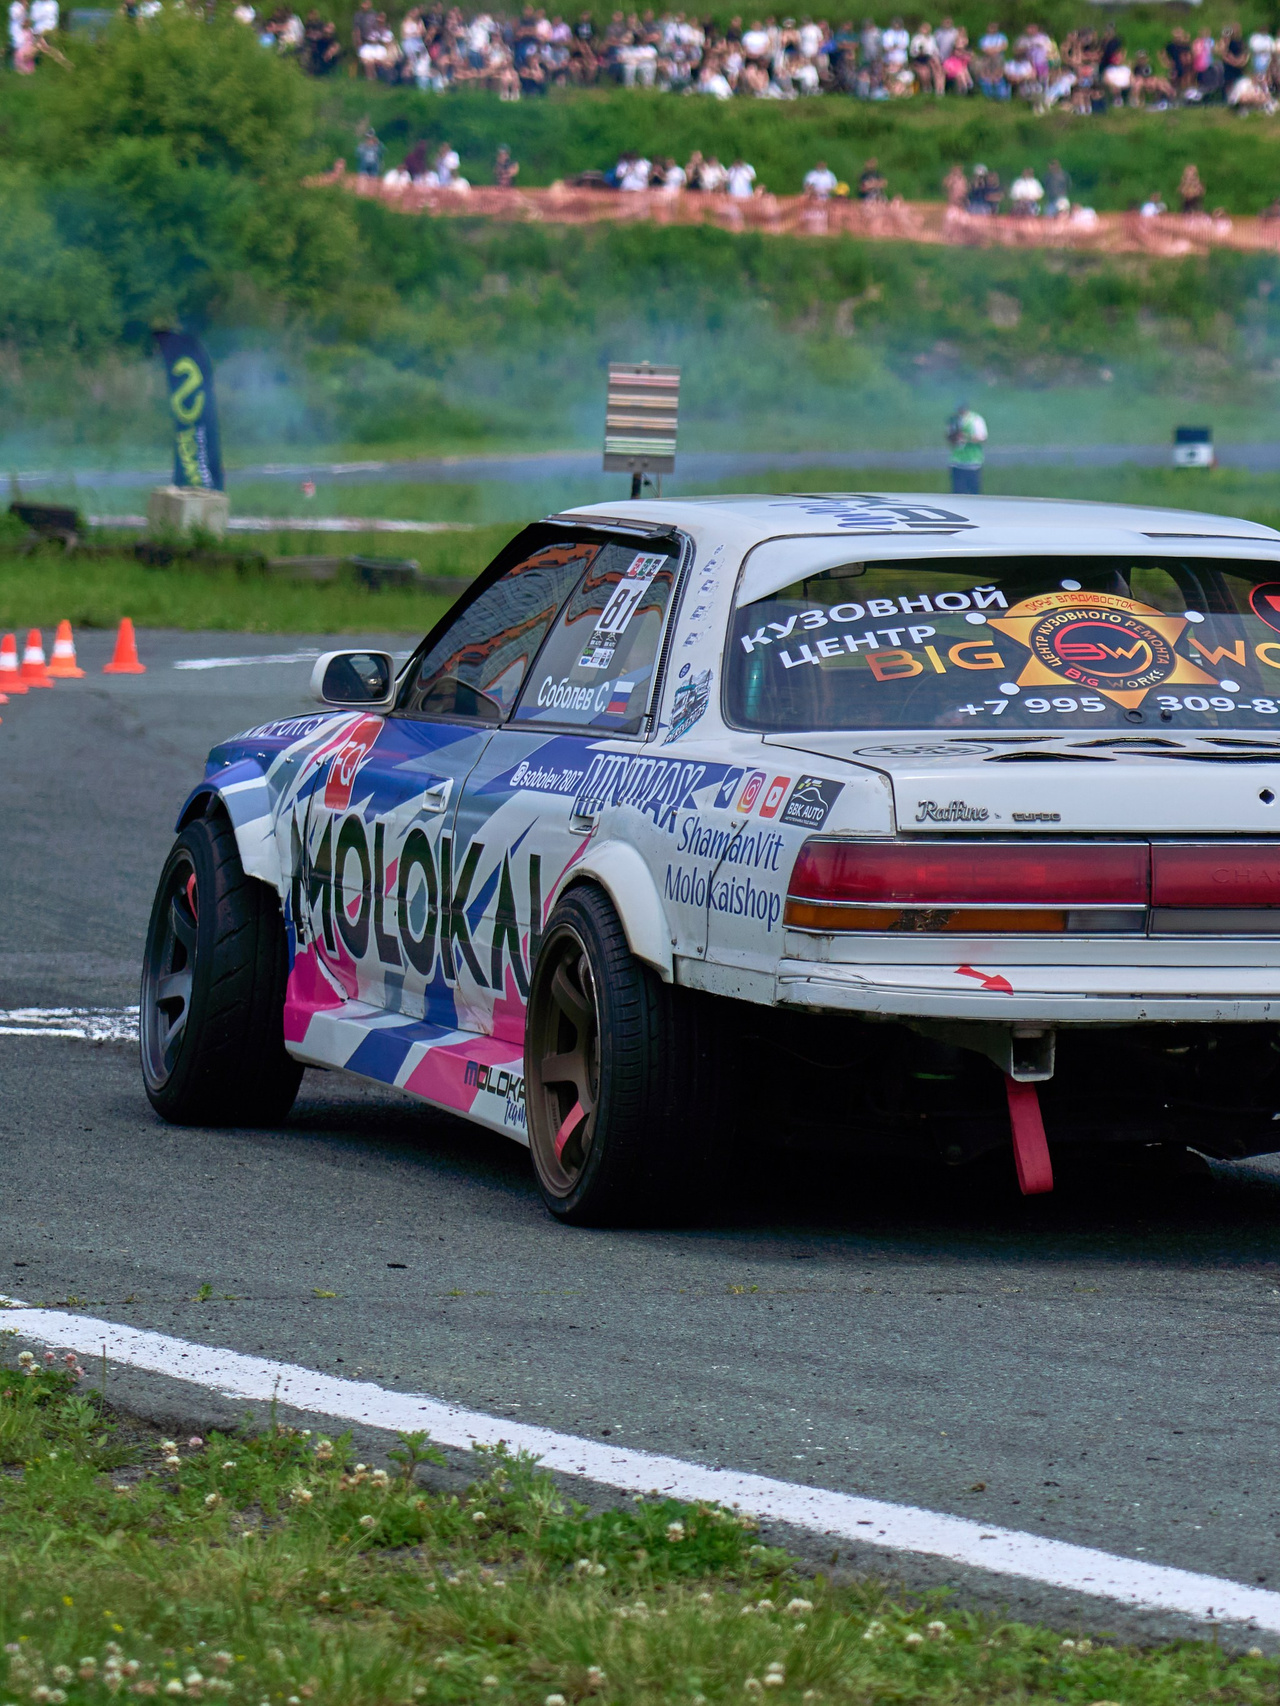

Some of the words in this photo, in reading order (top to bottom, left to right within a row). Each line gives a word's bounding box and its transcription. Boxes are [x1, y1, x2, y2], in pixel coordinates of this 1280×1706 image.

[599, 588, 644, 631] 81
[740, 586, 1009, 653] КУЗОВНОЙ
[1037, 610, 1122, 636] КУЗОВНОГО
[1056, 594, 1136, 611] ВЛАДИВОСТОК
[779, 625, 936, 669] ЦЕНТР
[865, 640, 1006, 682] BIG
[1036, 634, 1062, 667] ЦЕНТР
[1125, 619, 1170, 665] РЕМОНТА
[537, 675, 594, 710] Соболев
[958, 699, 1009, 716] +7
[1024, 697, 1106, 714] 995
[329, 741, 366, 786] FQ
[509, 761, 584, 793] @sobolev7807
[802, 805, 825, 821] AUTO
[915, 800, 990, 822] Raffine
[676, 816, 785, 872] ShamanVit
[290, 804, 542, 992] MOLOKAI
[664, 864, 782, 932] Molokaishop
